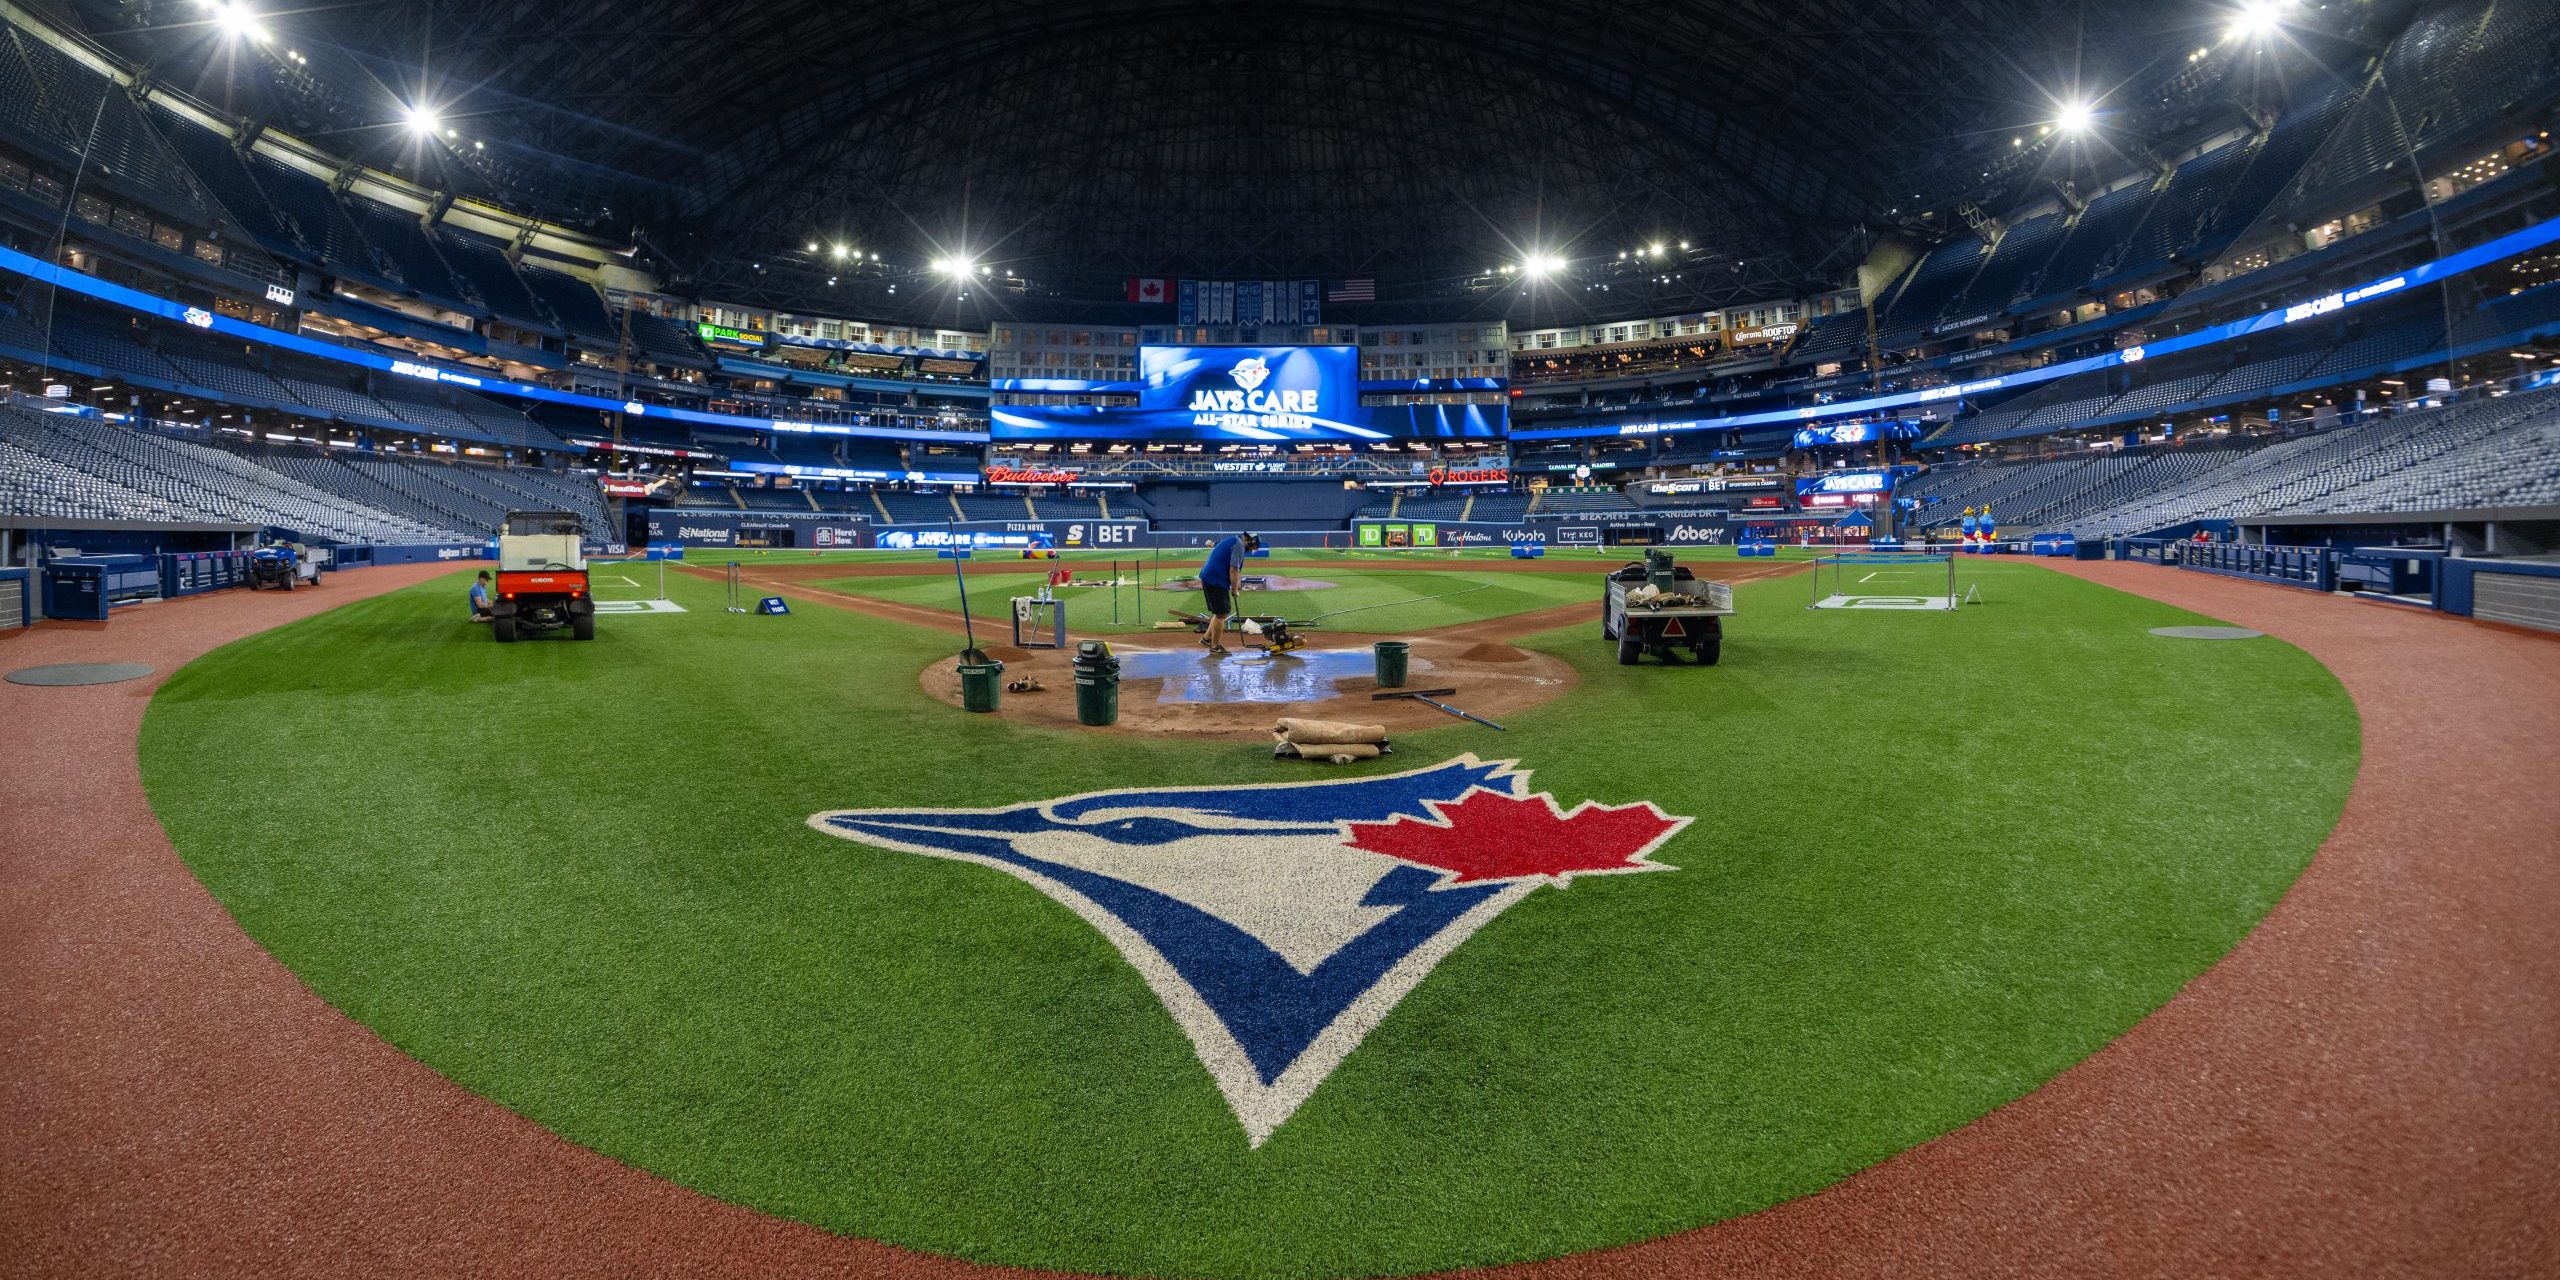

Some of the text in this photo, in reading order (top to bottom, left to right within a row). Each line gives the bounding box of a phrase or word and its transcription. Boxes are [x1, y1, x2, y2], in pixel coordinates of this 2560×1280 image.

[1941, 315, 1988, 332] JACKIE ROBINSON
[715, 328, 740, 338] PARK
[739, 333, 764, 342] SOCIAL
[1736, 325, 1798, 342] Corona ROOFTOP
[1965, 350, 1992, 362] BAUTISTA
[1886, 366, 1912, 376] HALLADAY
[658, 382, 698, 393] CARLOS DELGADO
[814, 402, 840, 410] FERNANDEZ
[1189, 390, 1318, 412] JAYS CARE
[1194, 414, 1313, 429] ALL-STAR SERIES
[1620, 424, 1638, 434] JAYS
[1638, 424, 1658, 433] CARE
[1214, 462, 1256, 472] WESTJET
[986, 466, 1078, 482] Budweiser
[1448, 469, 1508, 482] ROGERS
[610, 484, 644, 493] BeautiTone
[1651, 483, 1700, 494] theScore
[1708, 481, 1727, 491] BET
[1823, 475, 1883, 490] JAYS CARE
[690, 528, 729, 538] National
[834, 528, 856, 536] Here's
[1007, 523, 1044, 531] PIZZA NOVA
[916, 532, 939, 545] JAYS
[973, 536, 1003, 544] ALL-STAR
[1098, 525, 1137, 543] BET
[1362, 528, 1379, 541] TD
[1415, 528, 1433, 541] TD
[1461, 531, 1492, 542] Hortons
[1503, 530, 1546, 542] Kubota
[607, 544, 625, 554] VISA
